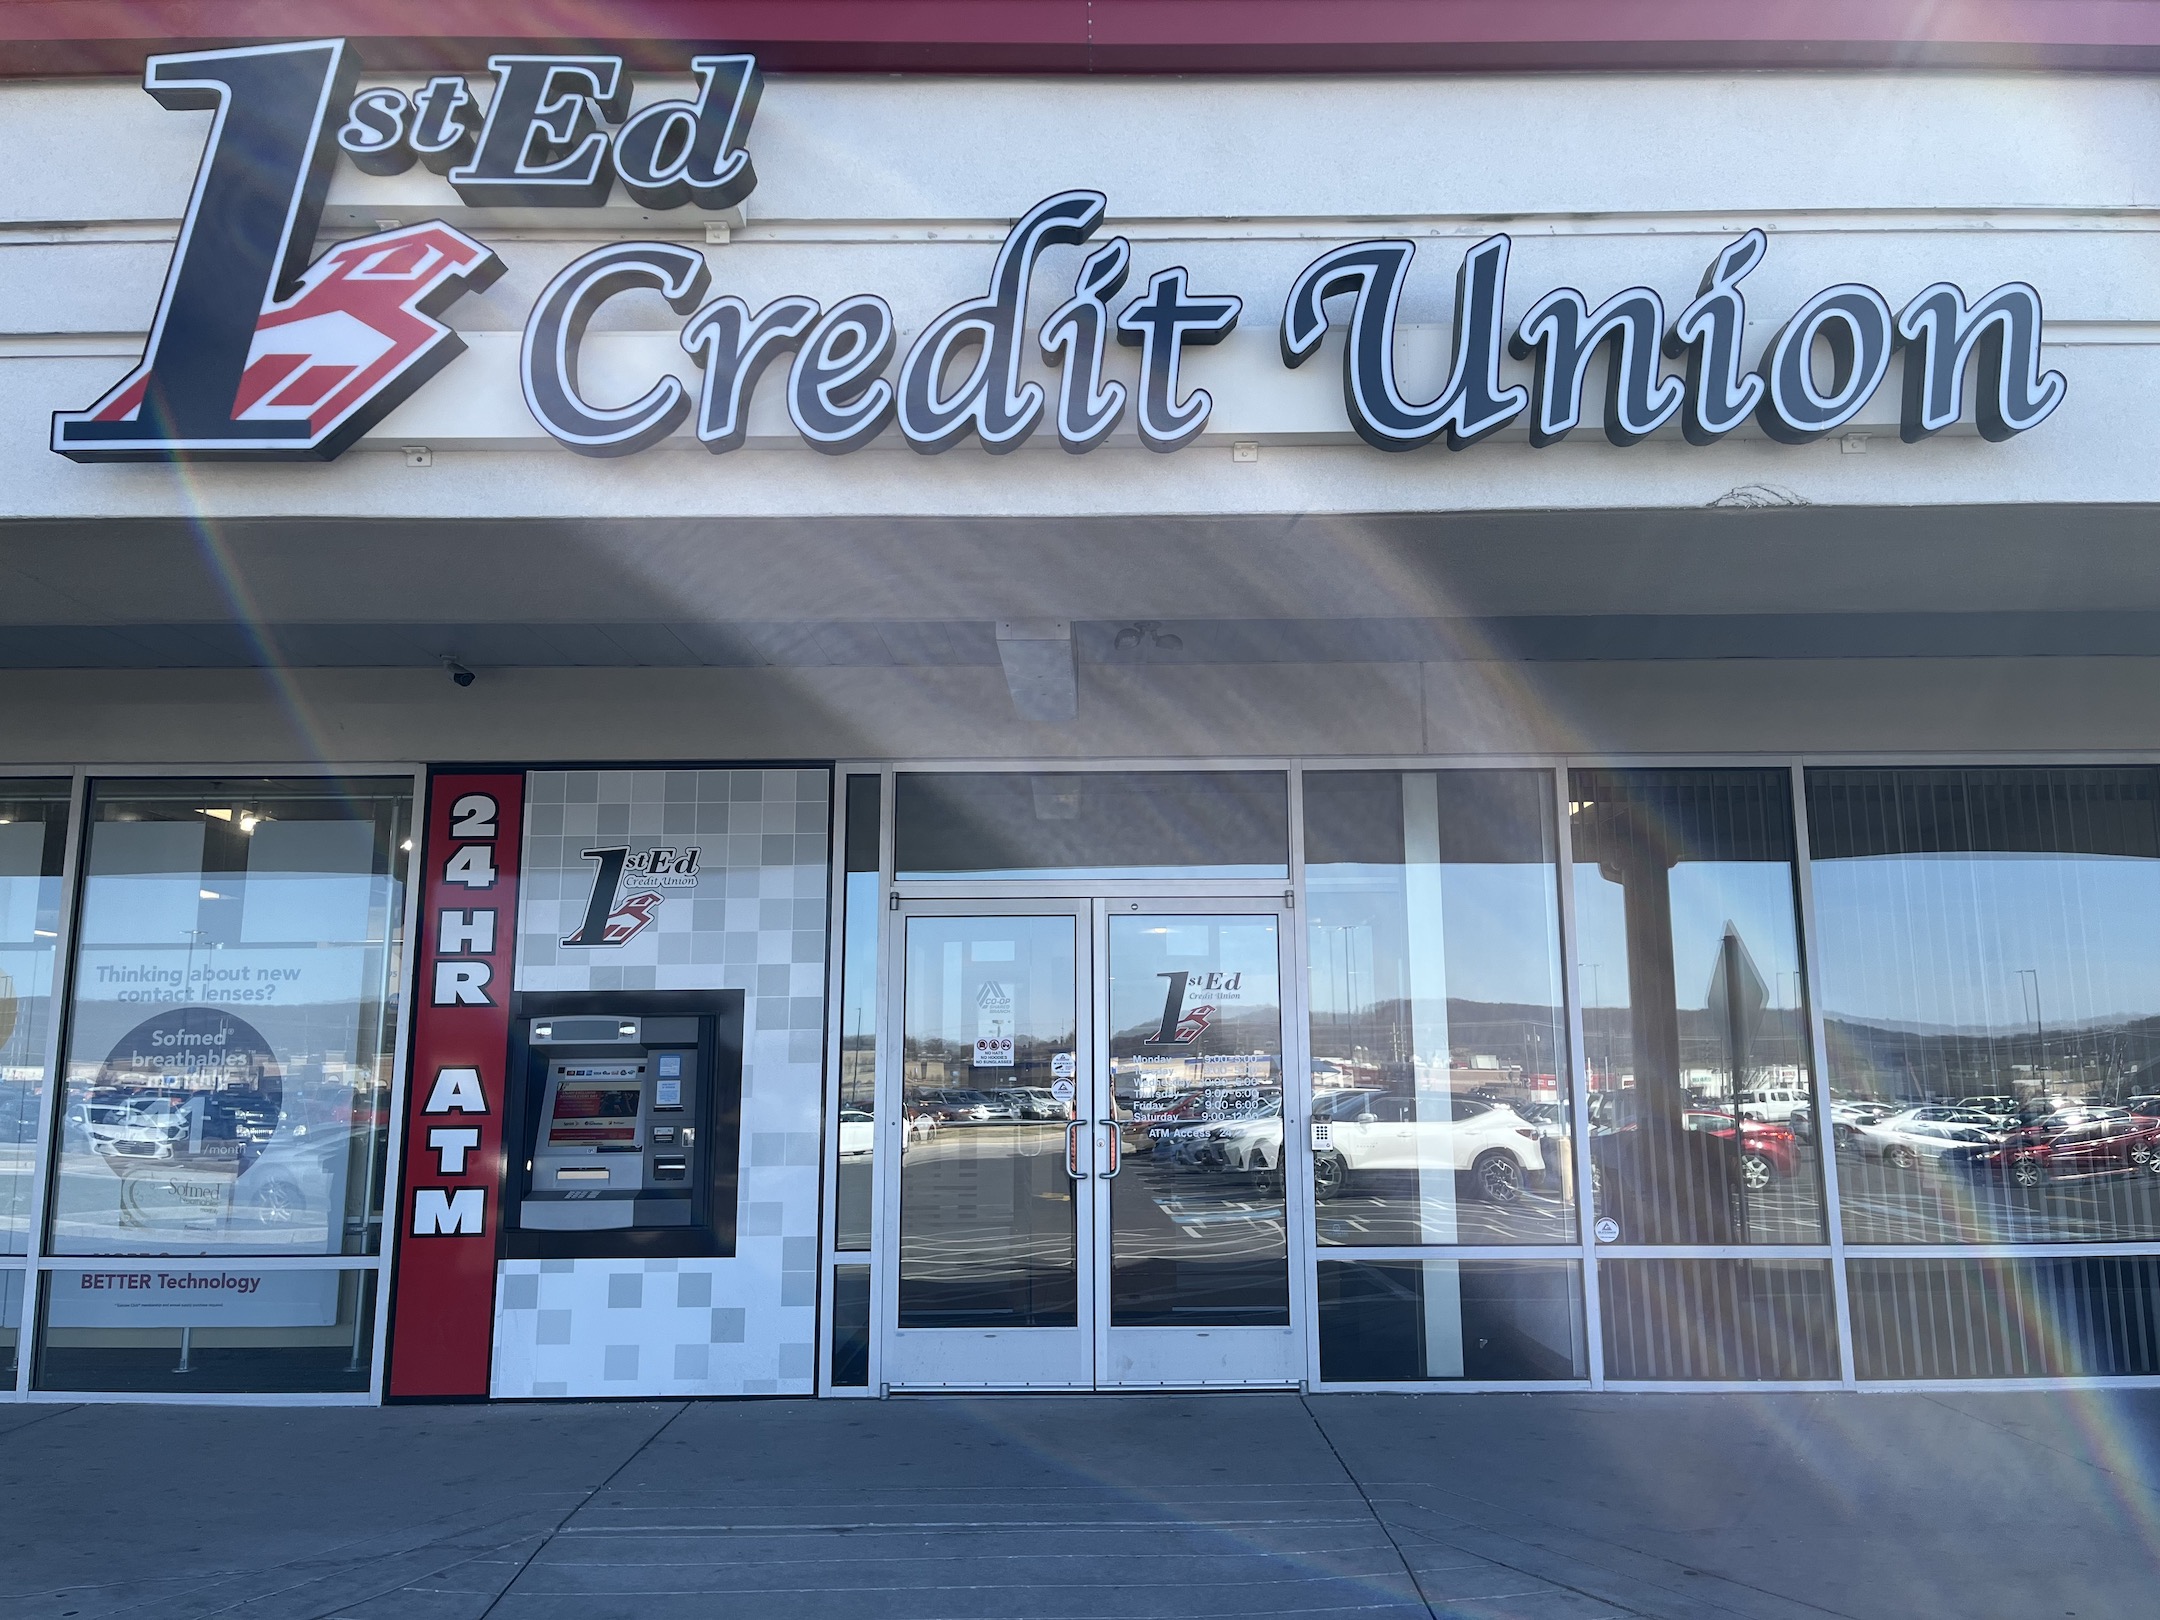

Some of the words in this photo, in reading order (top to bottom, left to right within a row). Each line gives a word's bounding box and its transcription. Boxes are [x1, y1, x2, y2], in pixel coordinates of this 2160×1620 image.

[520, 189, 1243, 455] Credit
[1282, 228, 2067, 450] Union
[443, 794, 499, 888] 24
[626, 876, 658, 886] Credit
[661, 876, 695, 886] Union
[431, 907, 498, 1007] HR
[97, 965, 183, 987] Thinking
[190, 964, 250, 982] about
[257, 968, 301, 981] new
[117, 986, 194, 1003] contact
[202, 984, 276, 1001] lenses?
[1189, 992, 1213, 1000] Credit
[1214, 992, 1241, 1000] Union
[1133, 1055, 1172, 1065] Monday
[1134, 1090, 1180, 1101] Thursday
[1133, 1101, 1164, 1111] Friday
[1134, 1113, 1179, 1122] Saturday
[1149, 1129, 1169, 1138] ATM
[1173, 1129, 1211, 1138] Access
[410, 1065, 490, 1238] ATM
[168, 1178, 222, 1200] Sofmed
[81, 1274, 151, 1289] BETTER
[158, 1273, 261, 1293] Technology
